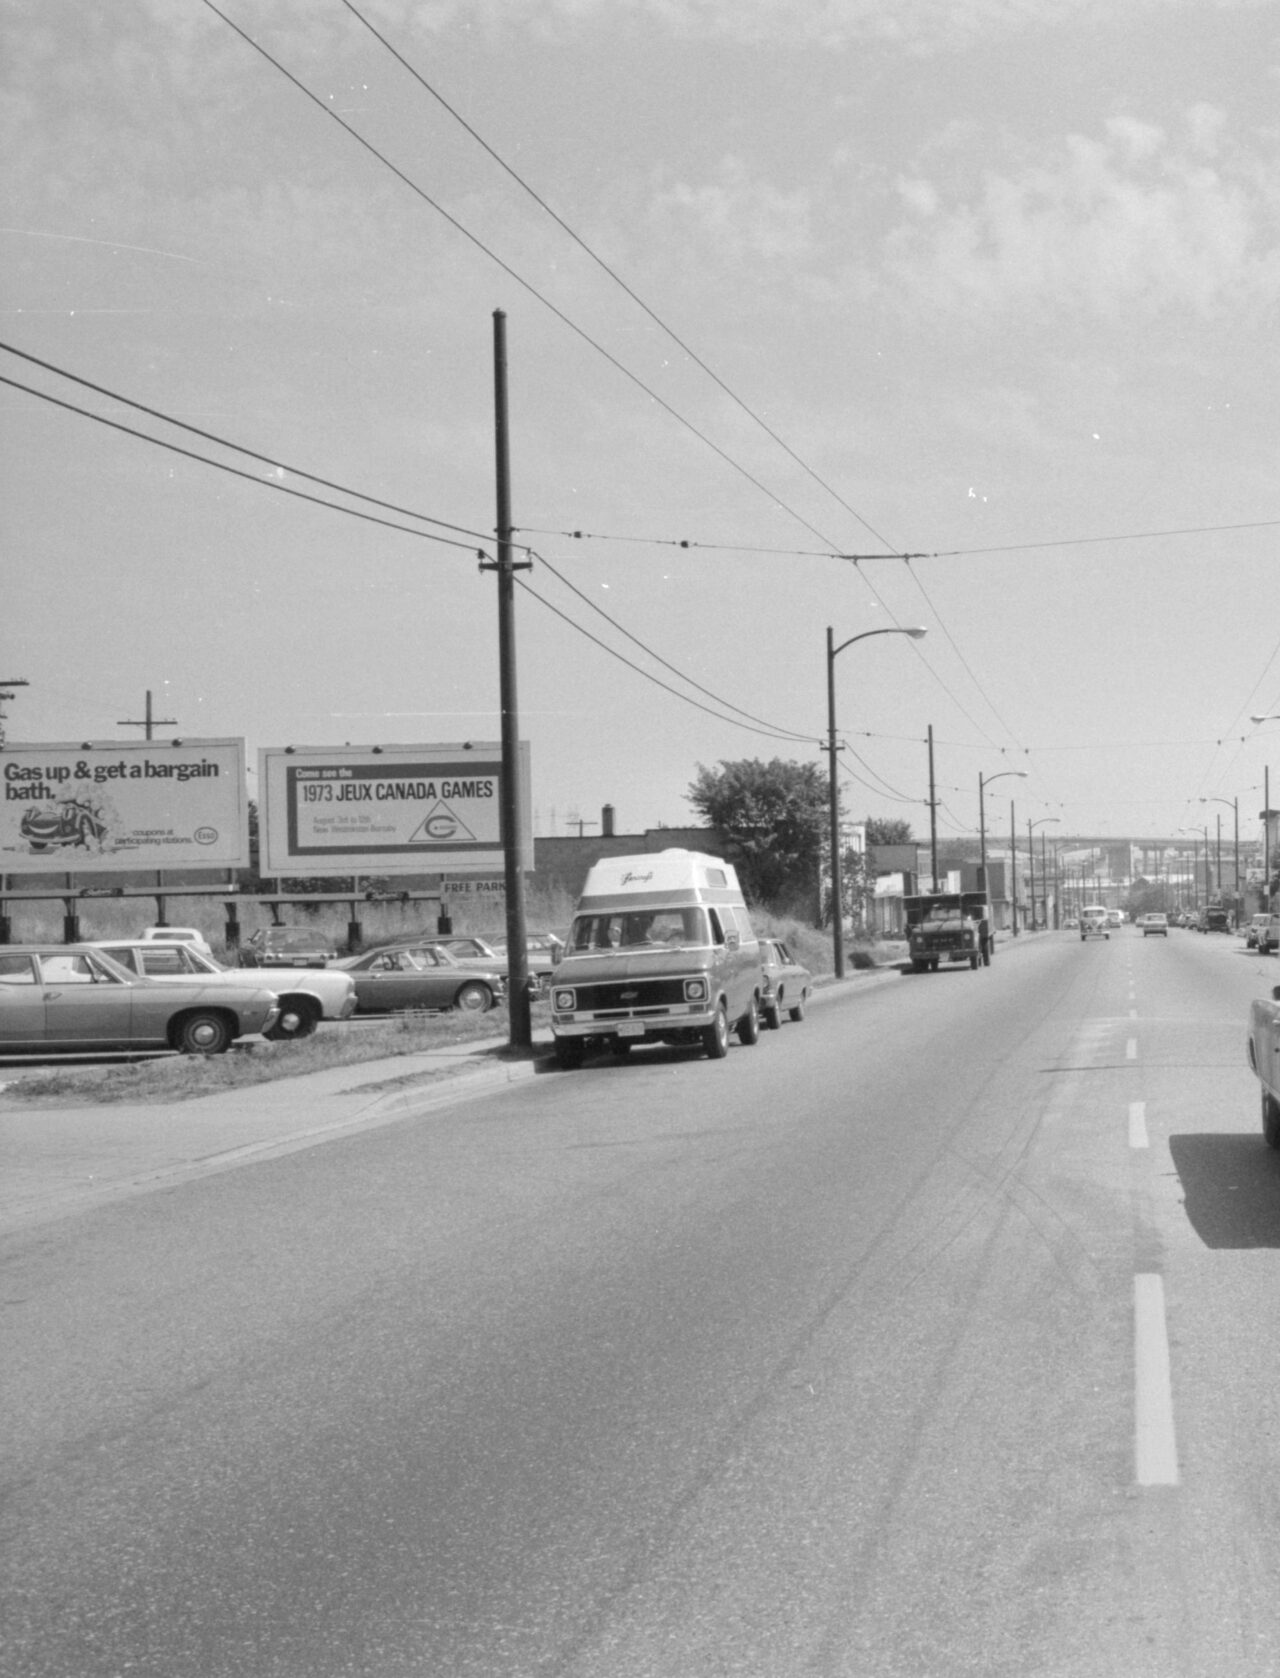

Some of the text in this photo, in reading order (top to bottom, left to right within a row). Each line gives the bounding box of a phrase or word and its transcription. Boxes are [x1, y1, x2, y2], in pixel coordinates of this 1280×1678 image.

[4, 759, 219, 783] Gas up & get a bargain
[295, 767, 353, 778] Come see the
[6, 782, 56, 800] bath.
[303, 780, 494, 802] 1973 JEUX CANADA GAMES
[132, 829, 165, 838] coupons
[444, 881, 507, 893] FREE PARK
